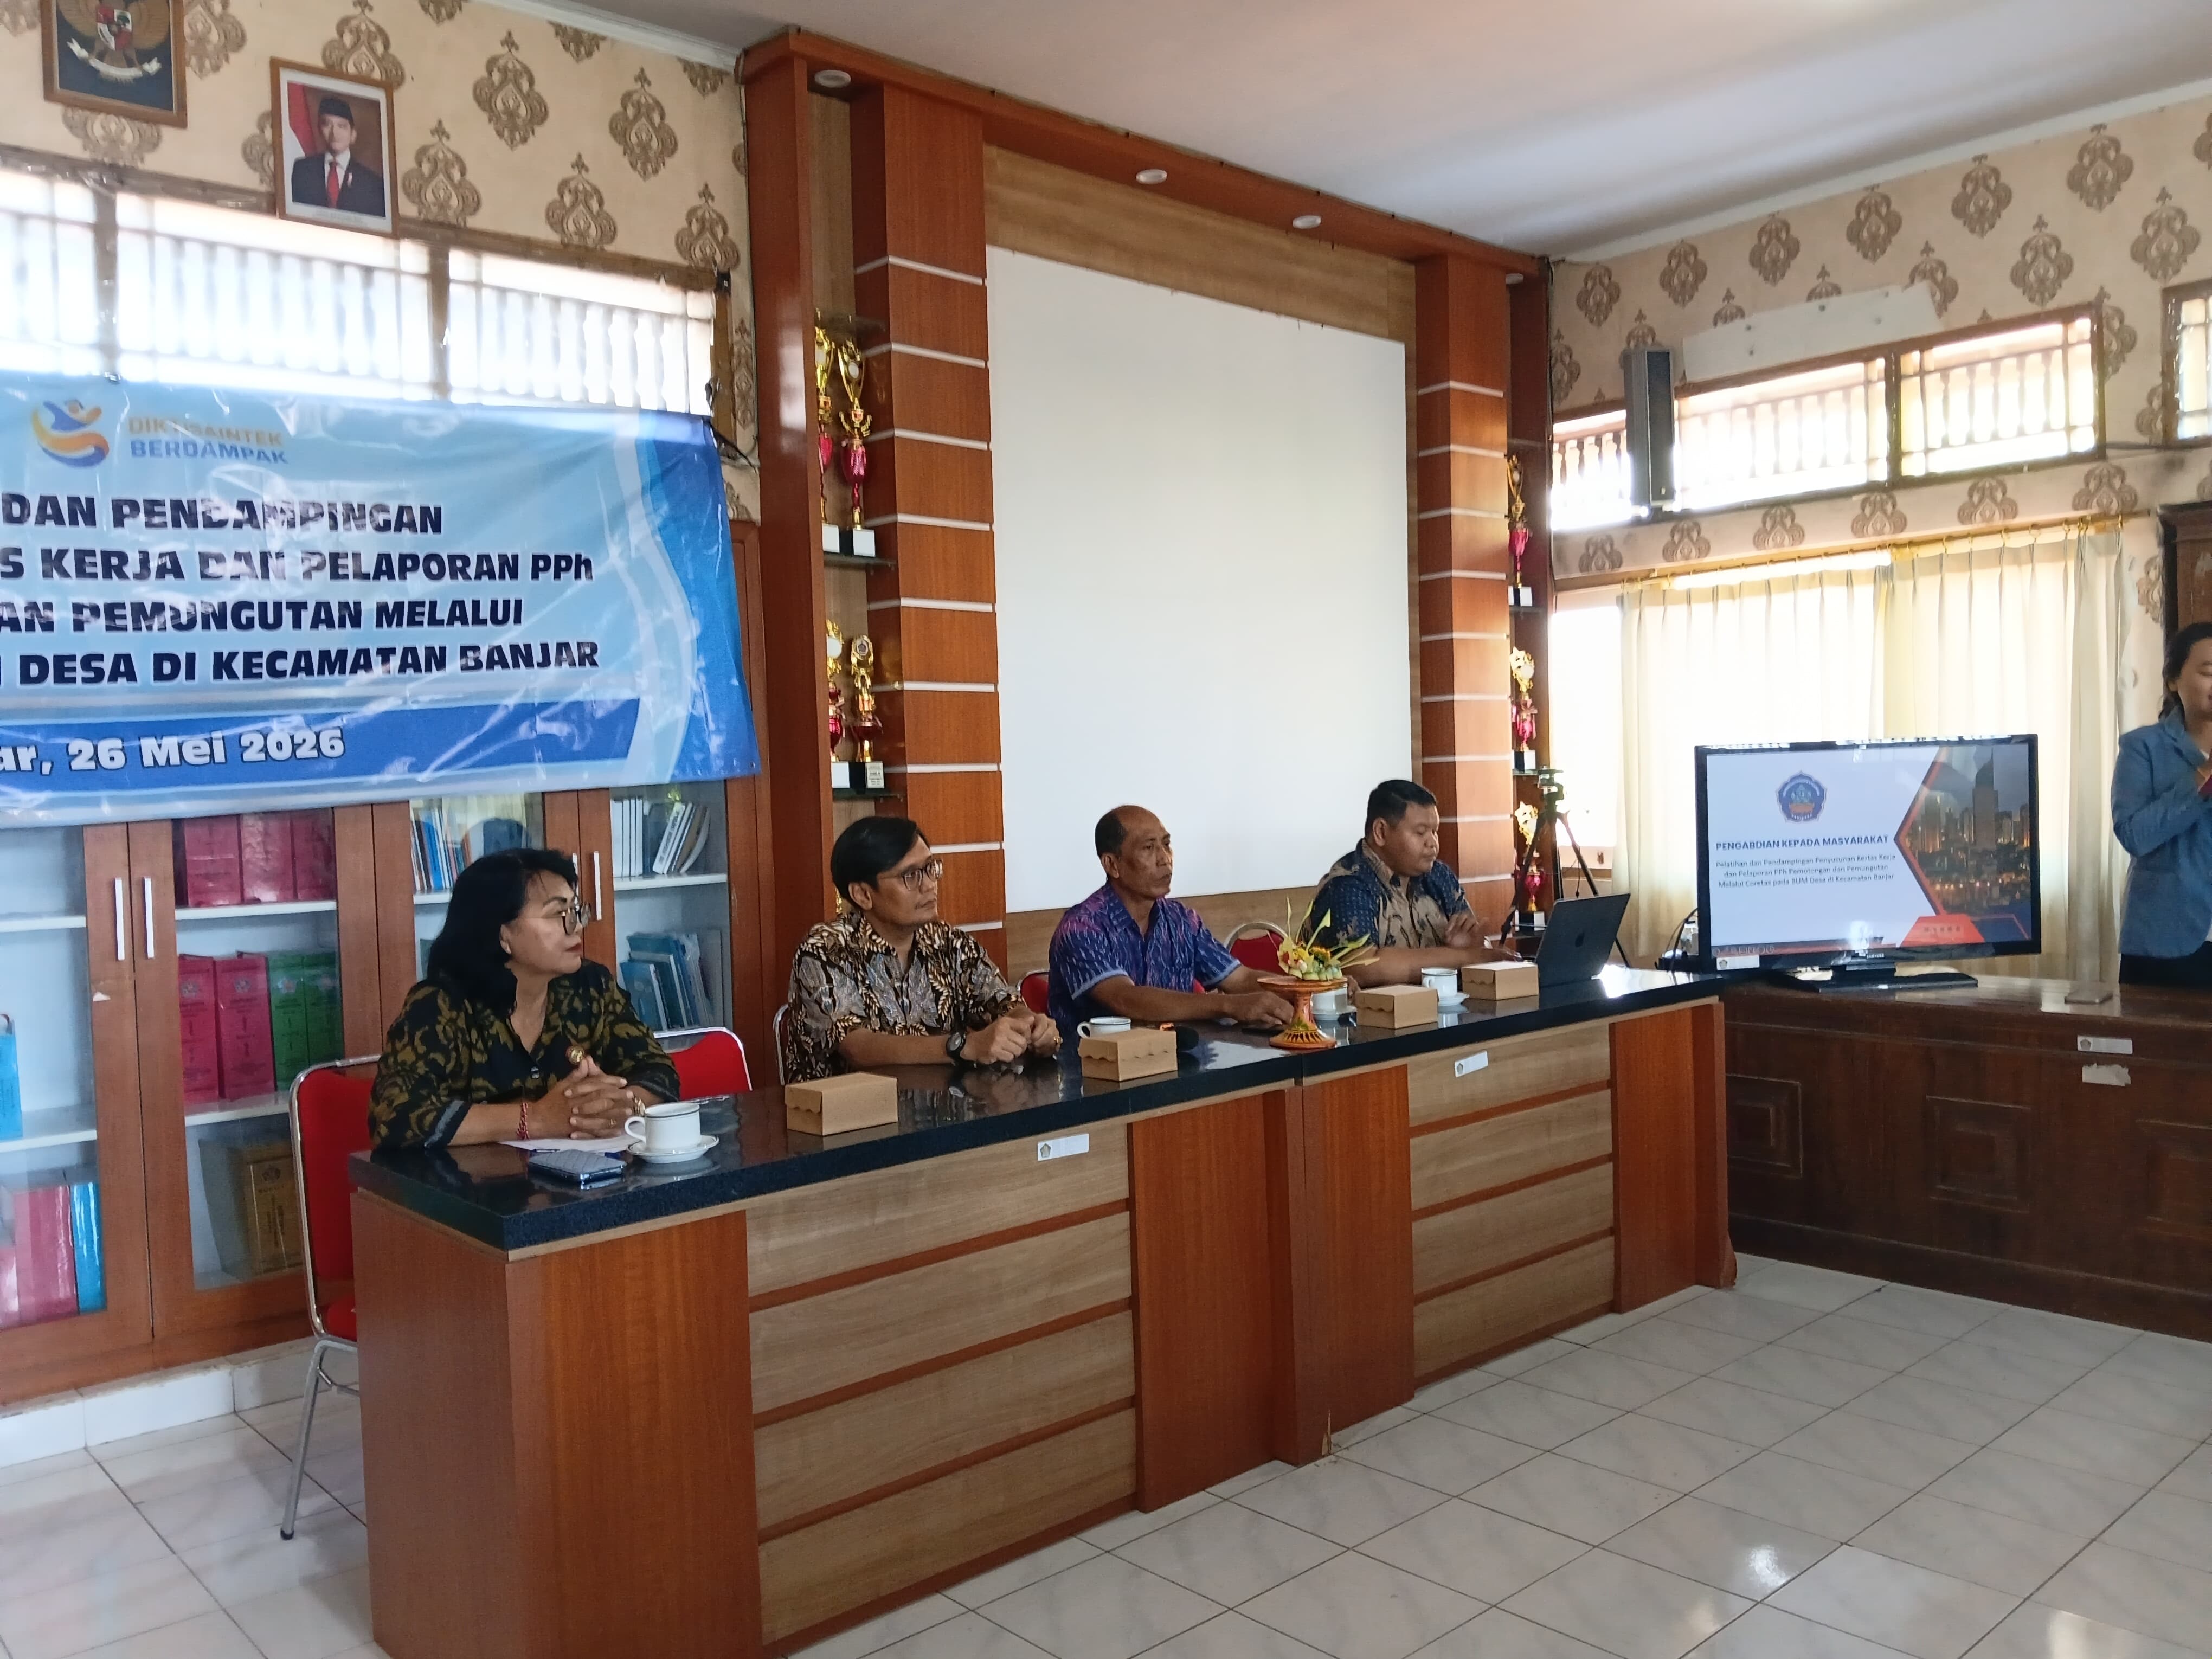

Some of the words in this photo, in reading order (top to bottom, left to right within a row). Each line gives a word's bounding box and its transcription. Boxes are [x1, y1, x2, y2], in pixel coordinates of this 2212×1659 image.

[131, 438, 288, 464] BERDAMPAK
[2, 492, 97, 526] DAN
[41, 549, 185, 580] KERJA
[198, 550, 286, 580] DAN
[301, 550, 519, 581] PELAPORAN
[531, 554, 593, 580] PPh
[72, 601, 362, 632] PEMUNGUTAN
[375, 599, 522, 628] MELALUI
[20, 653, 138, 685] DESA
[153, 652, 196, 683] DI
[213, 646, 447, 680] KECAMATAN
[460, 641, 599, 671] BANJAR
[67, 737, 126, 771] 26
[140, 731, 226, 768] Mei
[240, 726, 345, 762] 2026
[1716, 840, 1779, 850] PENGABDIAN
[1782, 838, 1820, 847] KEPADA
[1822, 835, 1888, 846] MASYARAKAT
[1739, 869, 1772, 878] Pelaporan
[1847, 864, 1888, 872] Pemungutan
[1764, 858, 1814, 866] Pendampingan
[1836, 874, 1872, 883] Kecamatan
[1873, 873, 1894, 881] Banjar
